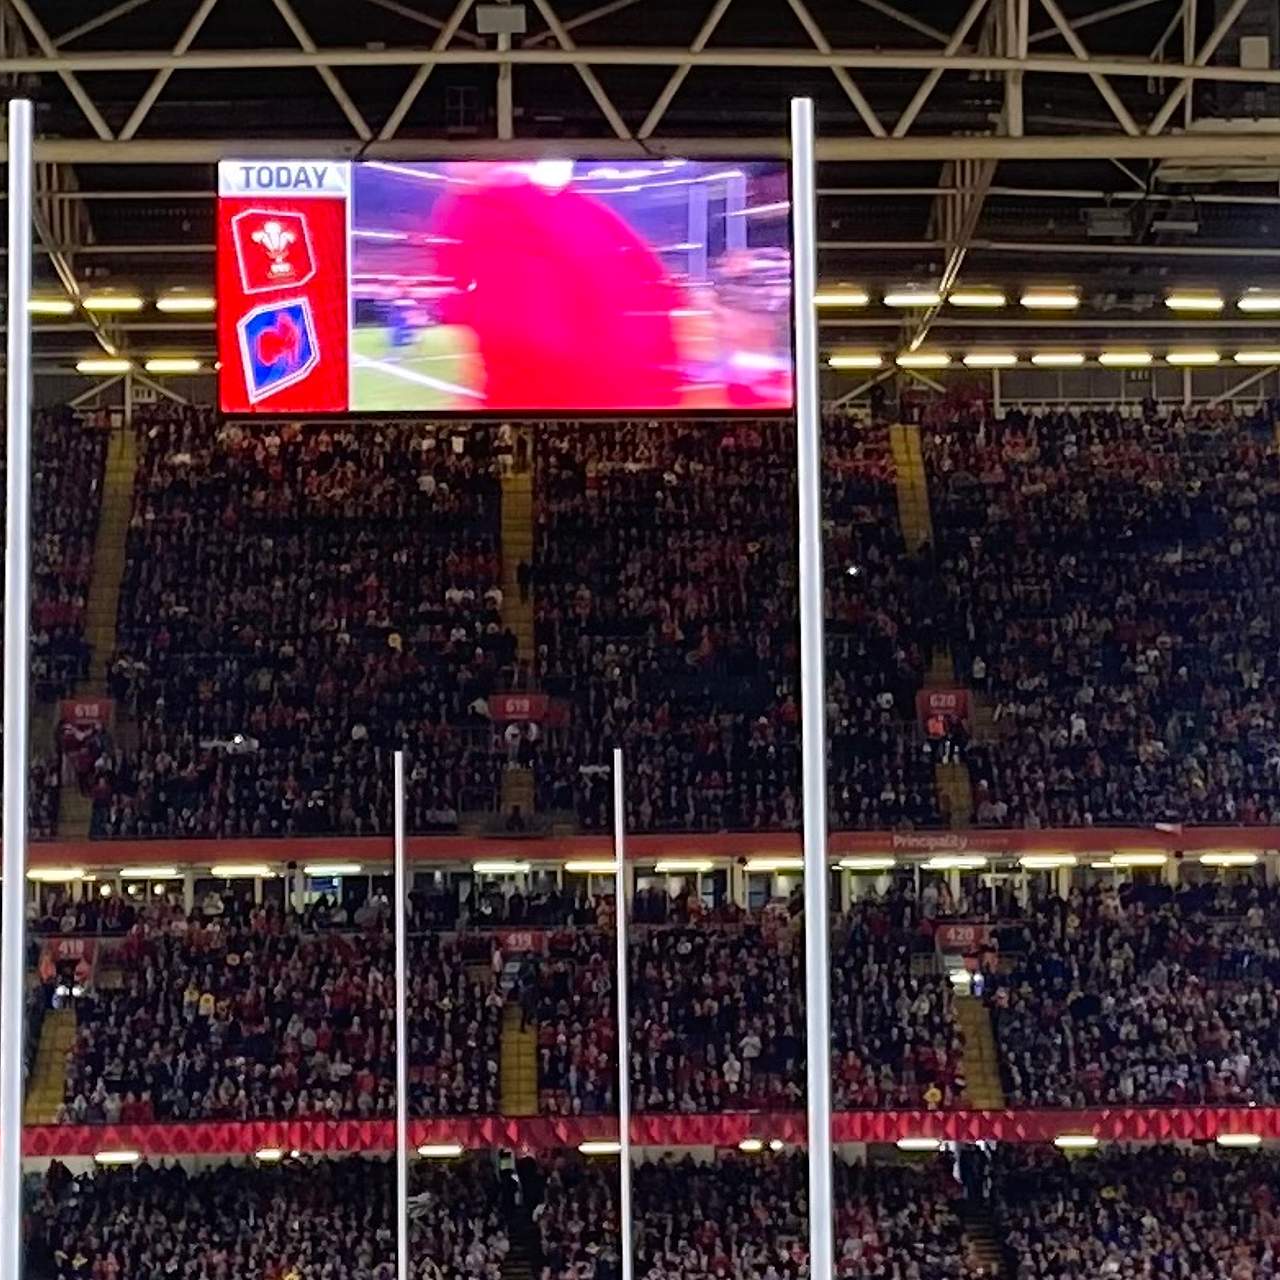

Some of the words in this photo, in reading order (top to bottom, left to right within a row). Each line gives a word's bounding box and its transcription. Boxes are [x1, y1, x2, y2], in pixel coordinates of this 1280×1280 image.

[241, 166, 328, 188] TODAY
[929, 694, 956, 707] 620
[893, 834, 968, 850] Principality
[947, 927, 975, 940] 420
